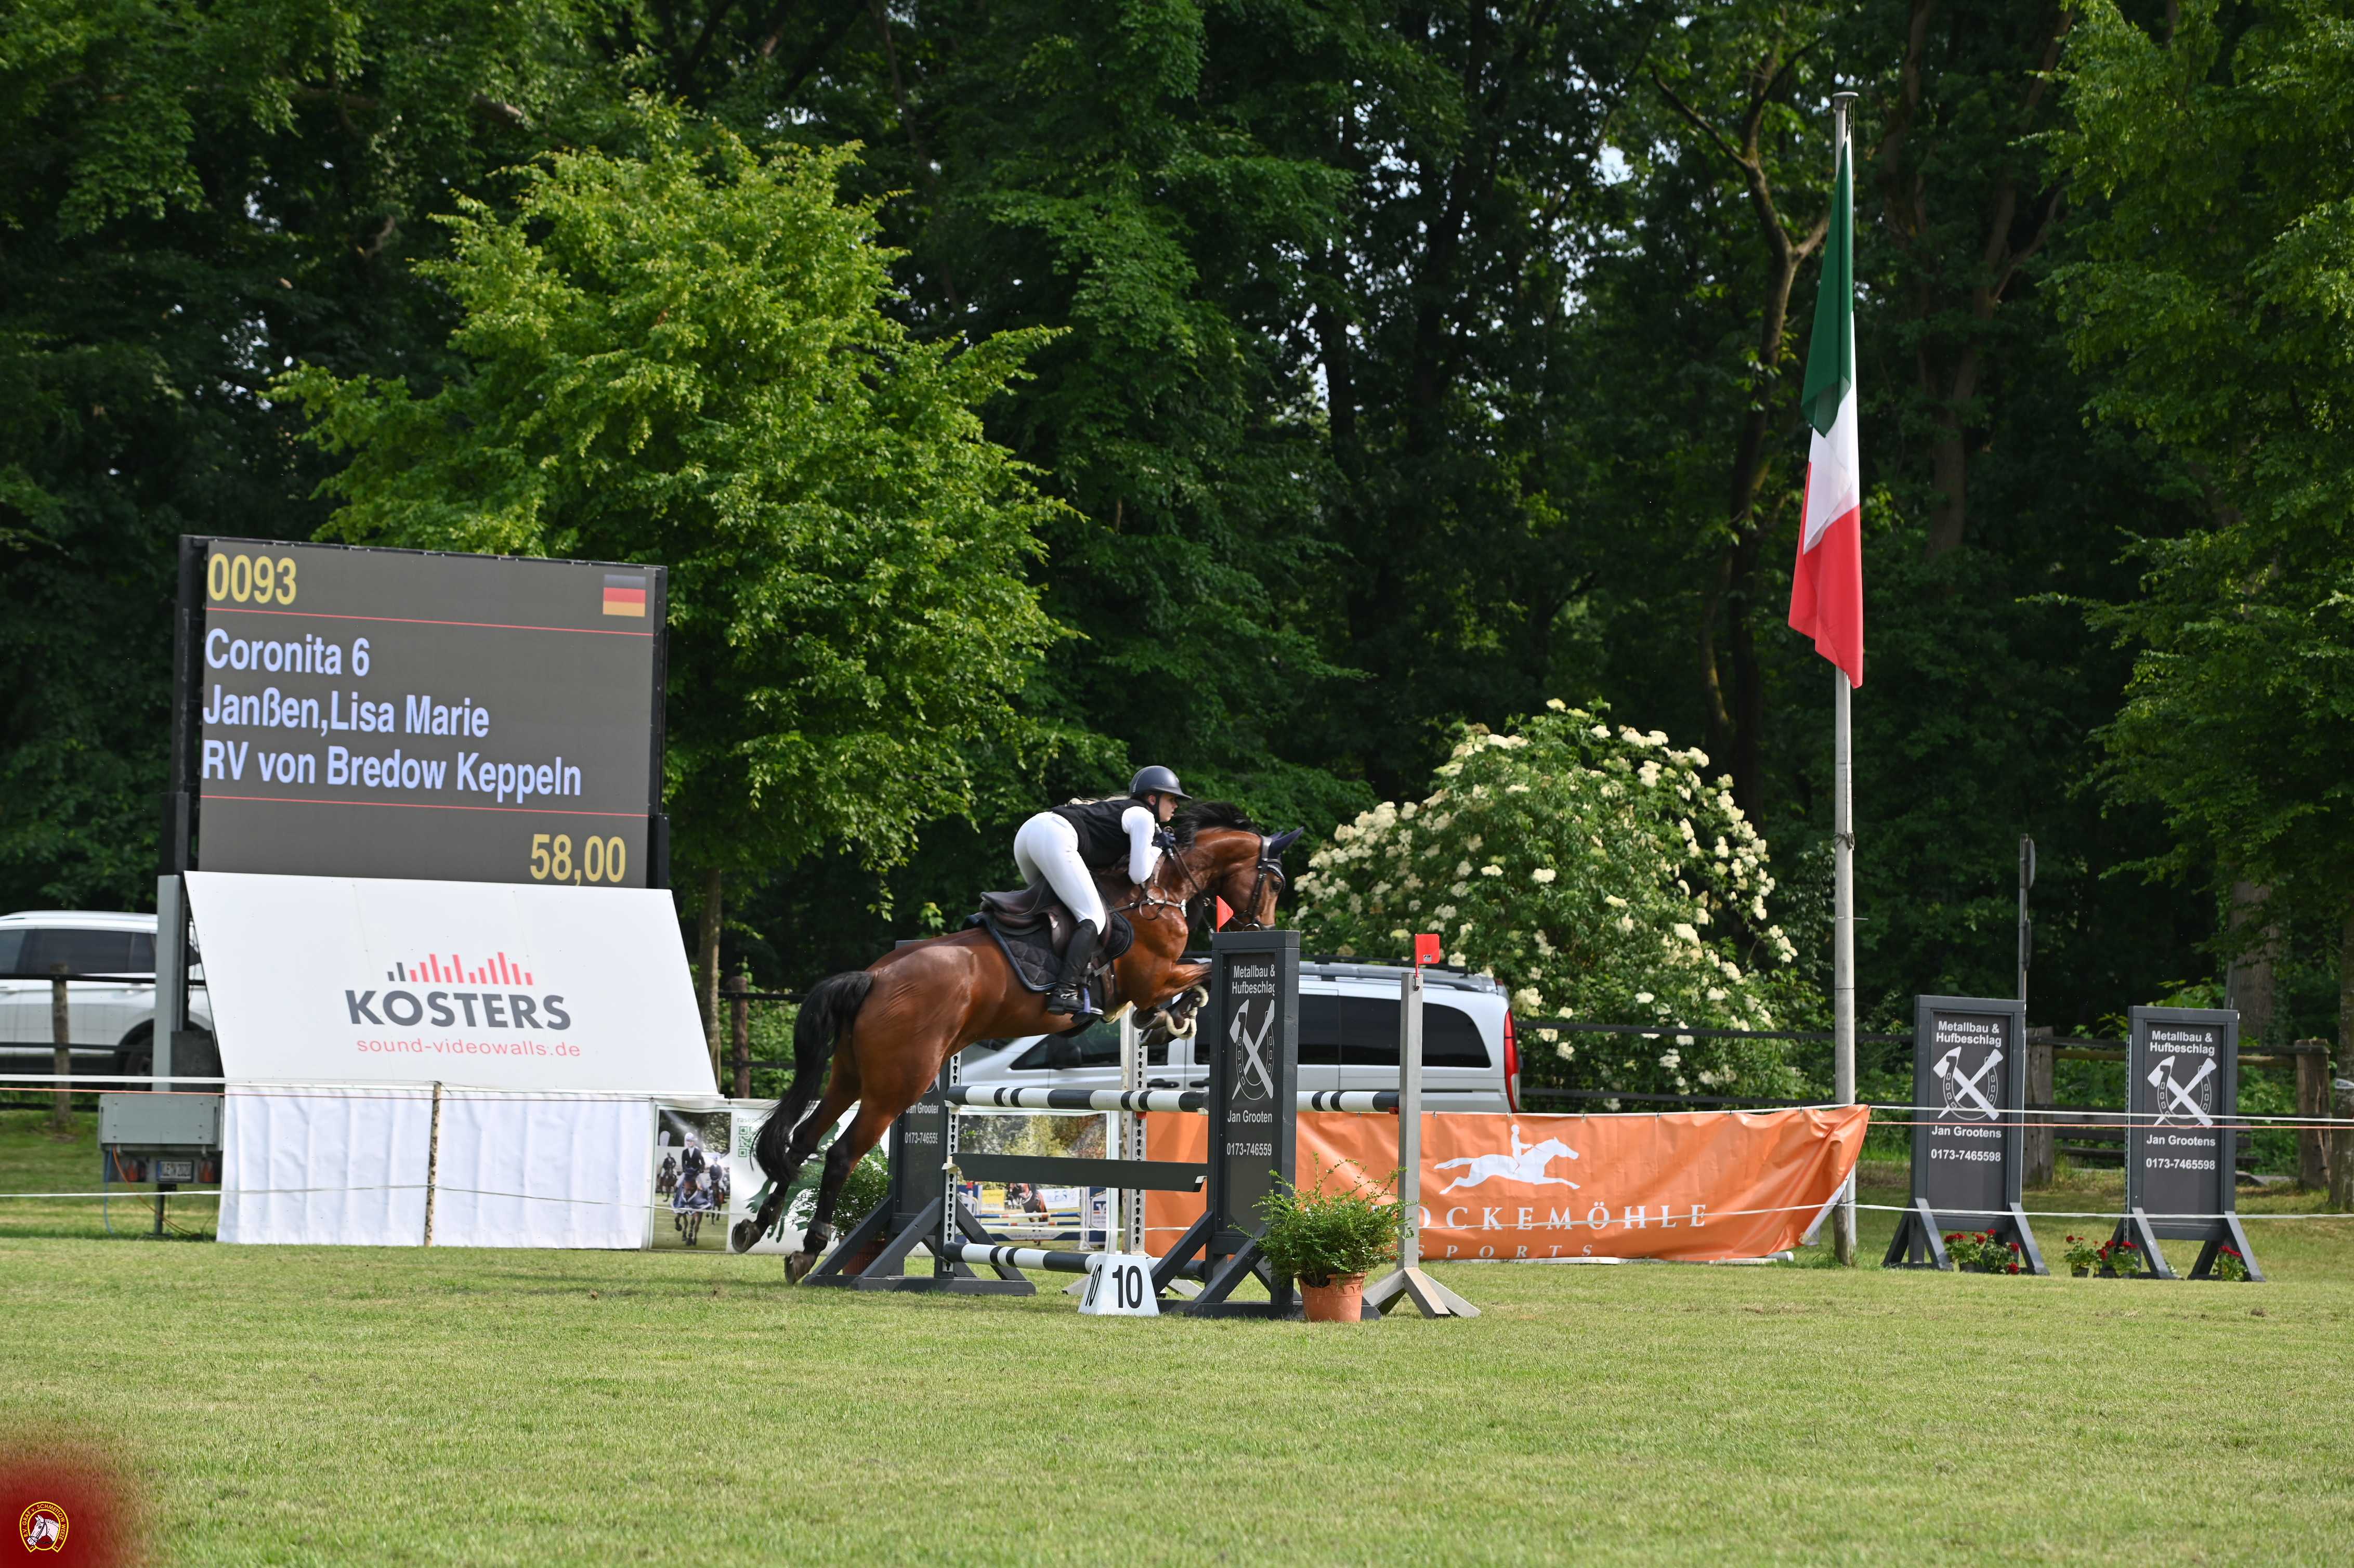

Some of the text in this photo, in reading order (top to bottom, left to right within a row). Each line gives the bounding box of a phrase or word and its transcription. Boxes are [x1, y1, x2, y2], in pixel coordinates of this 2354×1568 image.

[207, 553, 297, 605] 0093
[205, 628, 370, 676] Coronita 6
[202, 684, 490, 738] Janßen,Lisa Marie
[202, 739, 582, 804] RV von Bredow Keppeln
[530, 833, 626, 886] 58,00
[1234, 964, 1275, 978] Metallbau &
[345, 989, 571, 1031] KOSTERS
[1938, 1021, 2000, 1034] Metallbau &
[1936, 1031, 2002, 1048] Hufbeschlag
[2152, 1030, 2213, 1042] Metallbau &
[356, 1038, 581, 1057] sound-videowalls.de
[2150, 1042, 2215, 1056] Hufbeschlag
[1227, 1109, 1273, 1123] Jan Grooten
[1931, 1125, 2002, 1138] Jan Grootens
[2146, 1134, 2216, 1147] Jan Grootens
[1226, 1142, 1272, 1156] 0173-746559
[1931, 1148, 2001, 1162] 0173-7465598
[2146, 1158, 2215, 1170] 0173-7465598
[1085, 1263, 1143, 1309] 10 10
